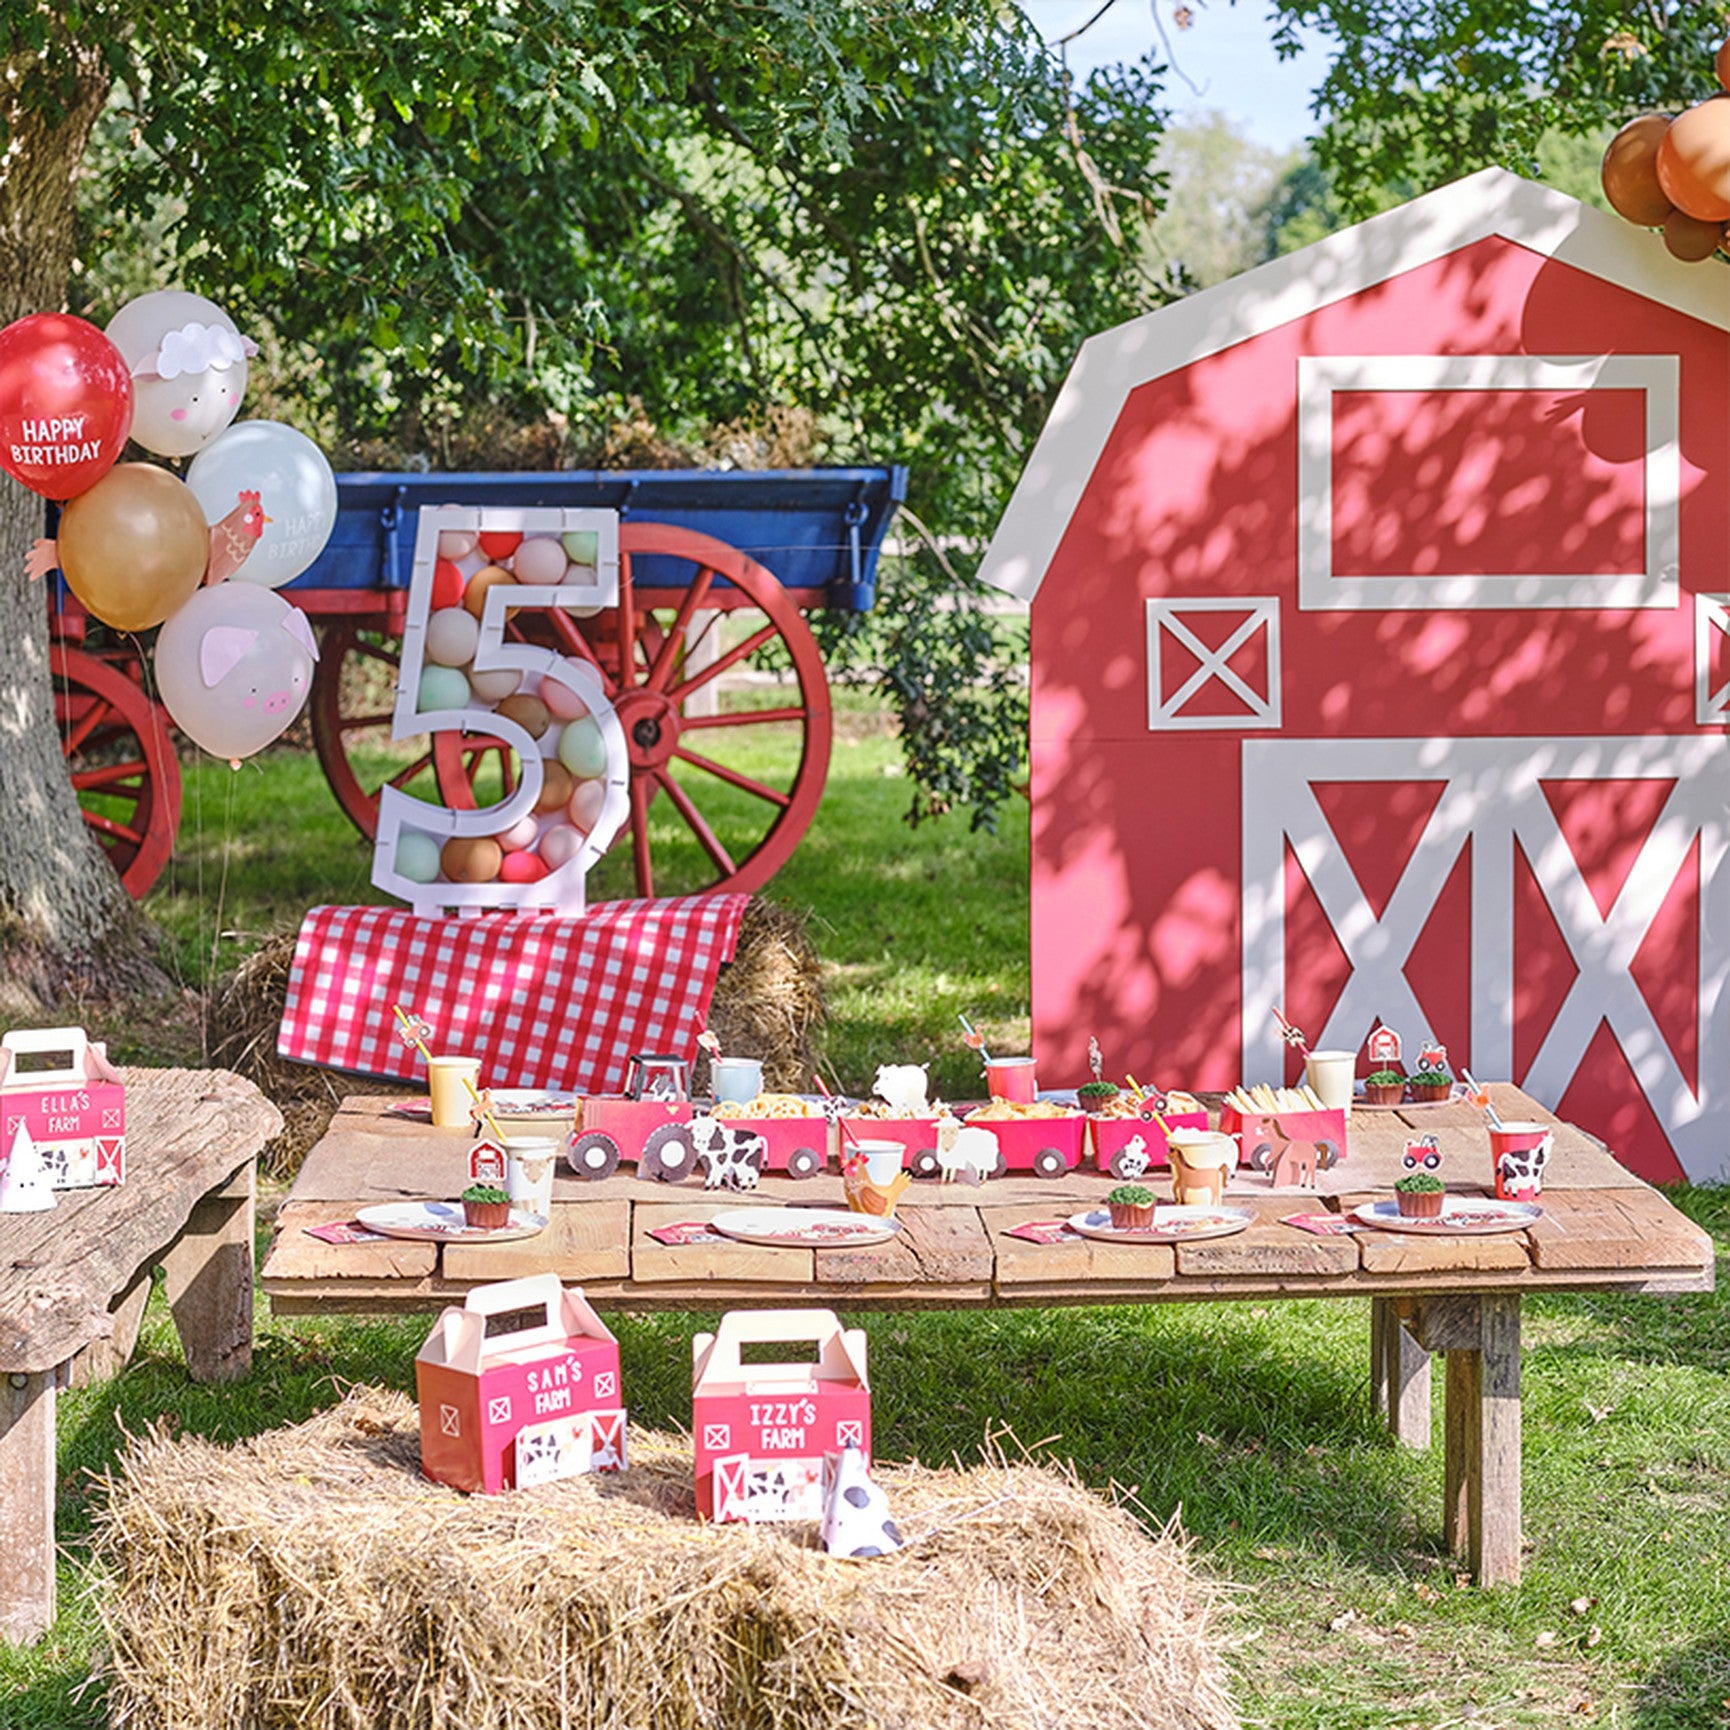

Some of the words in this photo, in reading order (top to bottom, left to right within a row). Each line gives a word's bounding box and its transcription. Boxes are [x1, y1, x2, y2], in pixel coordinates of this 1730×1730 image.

[22, 416, 84, 442] HAPPY
[10, 439, 101, 465] BIRTHDAY
[371, 505, 631, 917] 5
[41, 1091, 91, 1114] ELLA'S
[48, 1115, 81, 1133] FARM
[527, 1355, 582, 1393] SAM'S
[535, 1387, 571, 1415] FARM
[749, 1397, 817, 1426] IZZY'S
[761, 1427, 805, 1450] FARM
